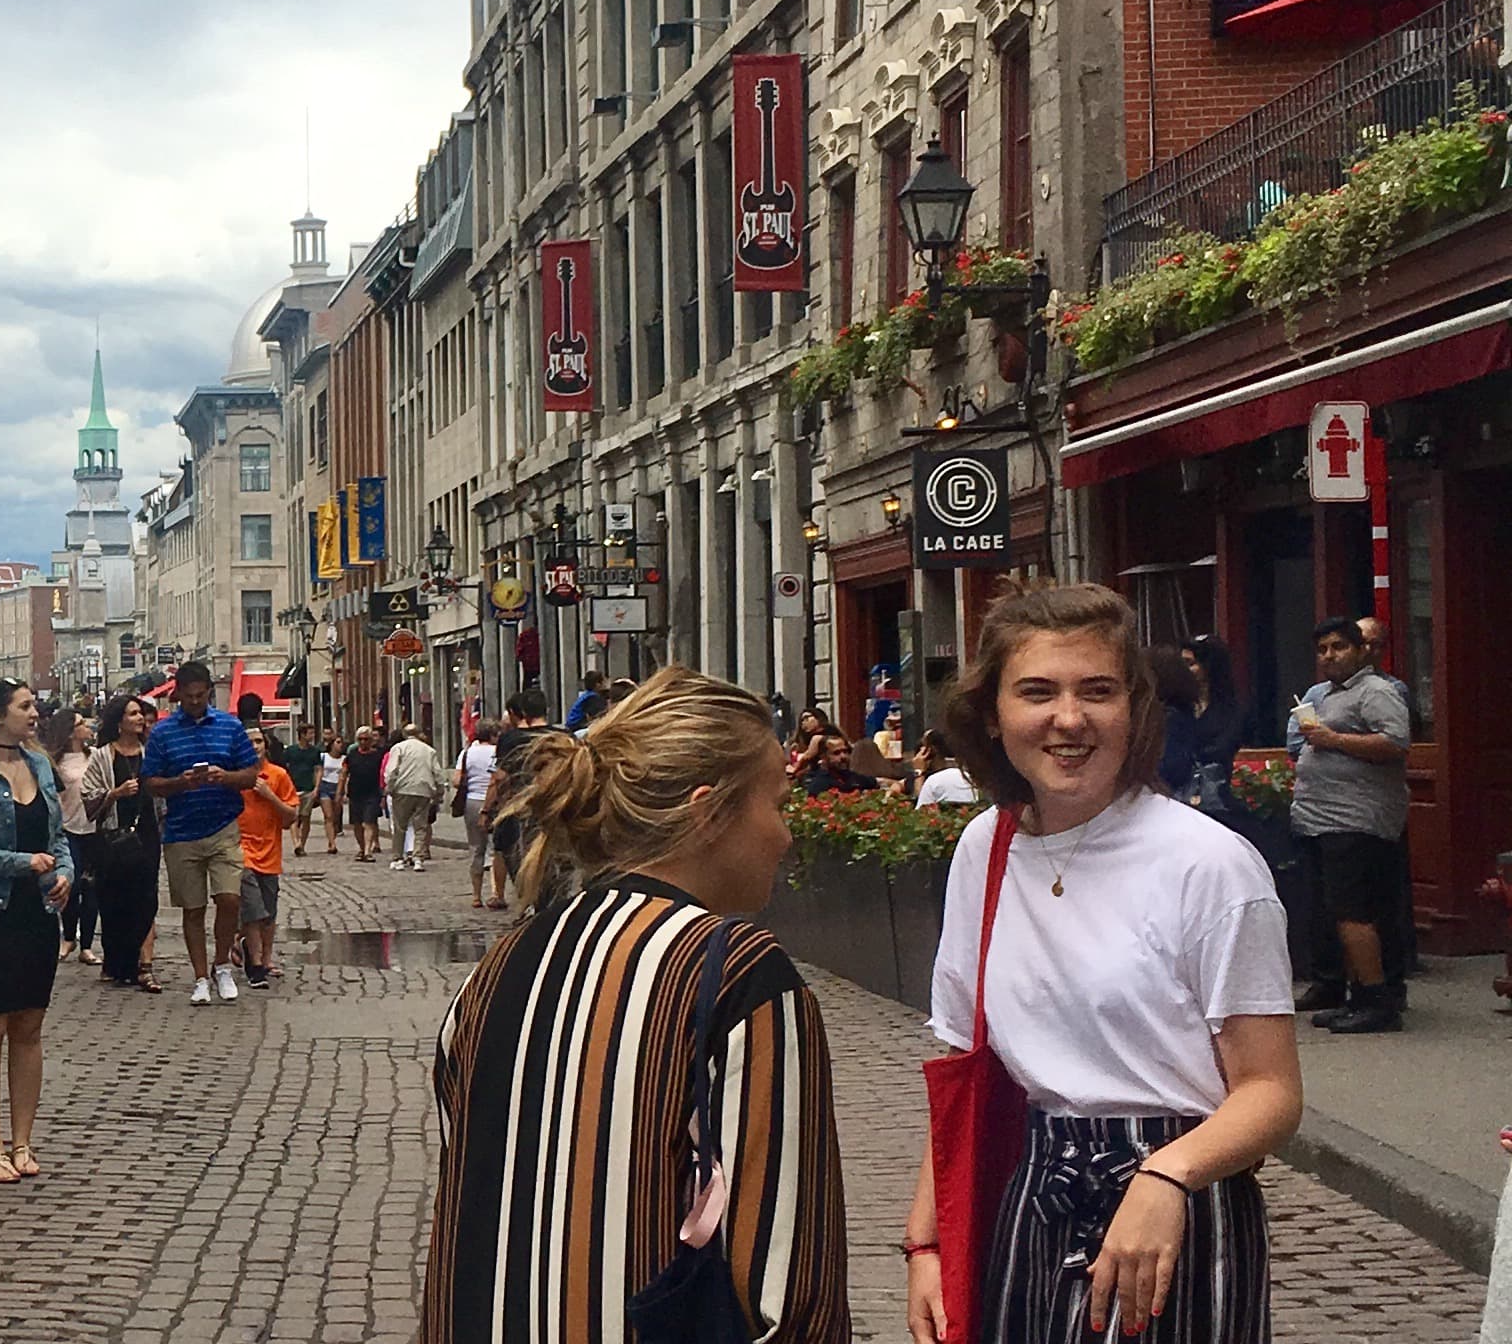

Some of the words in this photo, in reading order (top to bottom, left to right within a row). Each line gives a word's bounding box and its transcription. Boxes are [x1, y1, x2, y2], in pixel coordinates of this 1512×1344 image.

[742, 211, 760, 249] ST.
[762, 211, 794, 249] PAUL
[923, 536, 947, 551] LA
[952, 534, 1005, 551] CAGE
[577, 569, 644, 584] BILODEAU
